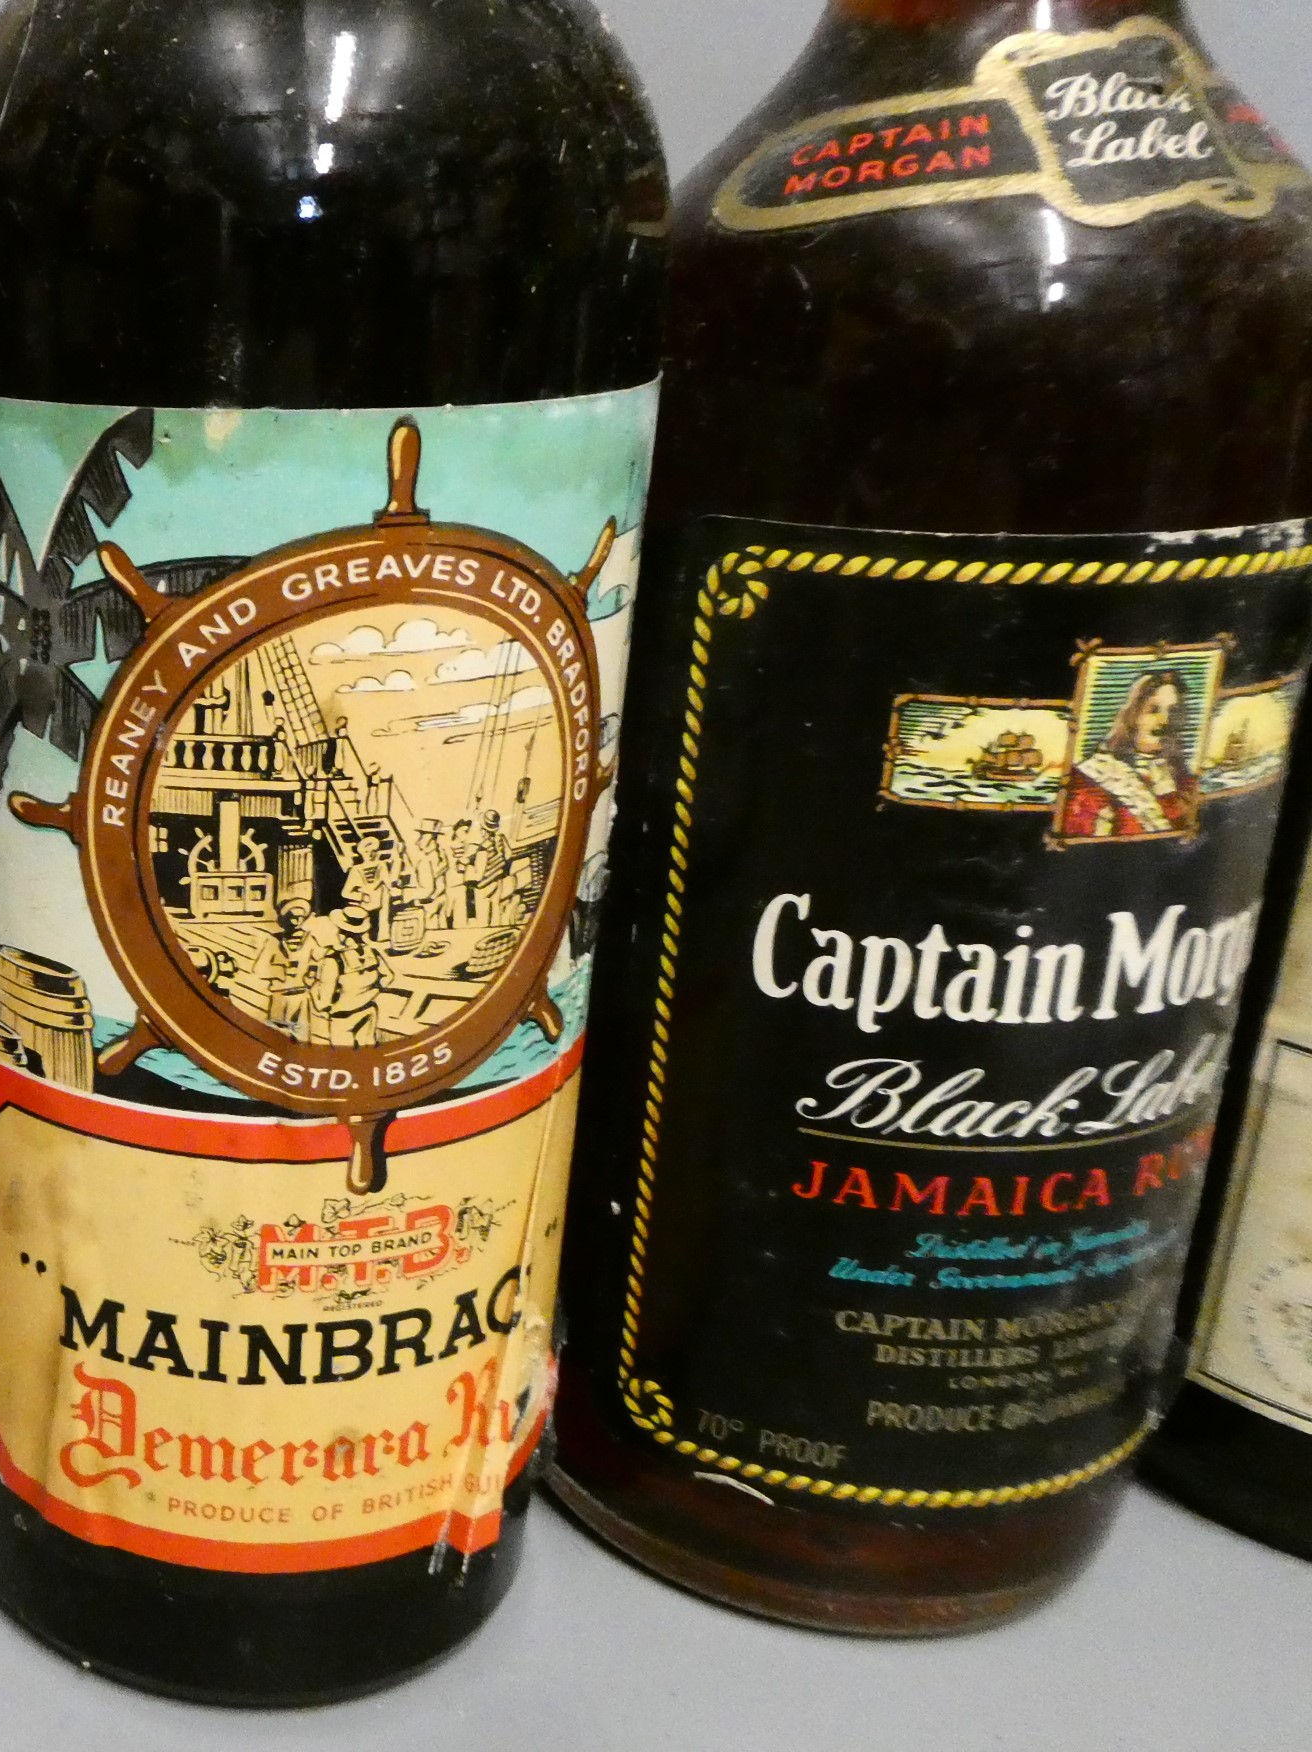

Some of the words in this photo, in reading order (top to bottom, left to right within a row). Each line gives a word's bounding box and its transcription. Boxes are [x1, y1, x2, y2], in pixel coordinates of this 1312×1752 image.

[789, 113, 989, 166] CAPTAIN
[1065, 117, 1215, 168] Label
[783, 146, 992, 197] MORGAN
[102, 668, 169, 828] REANEY
[175, 596, 258, 670] AND
[281, 552, 481, 604] GREAVES
[489, 570, 542, 624] LTD.
[546, 617, 590, 802] BRADFORD
[752, 893, 1087, 1034] Captain
[256, 1050, 359, 1091] ESTD.
[372, 1042, 454, 1086] 1825
[794, 1056, 1099, 1139] Black
[792, 1160, 1112, 1217] JAMAICA
[271, 1247, 320, 1260] MAIN
[329, 1243, 362, 1258] TOP
[371, 1231, 433, 1254] BRAND
[322, 1299, 384, 1313] REGISTERED
[835, 1310, 986, 1341] CAPTAIN
[59, 1360, 431, 1490] Demerara
[759, 1429, 847, 1468] PROOF
[168, 1496, 291, 1524] PRODUCE
[311, 1502, 345, 1522] OF
[362, 1473, 454, 1515] BRITISH
